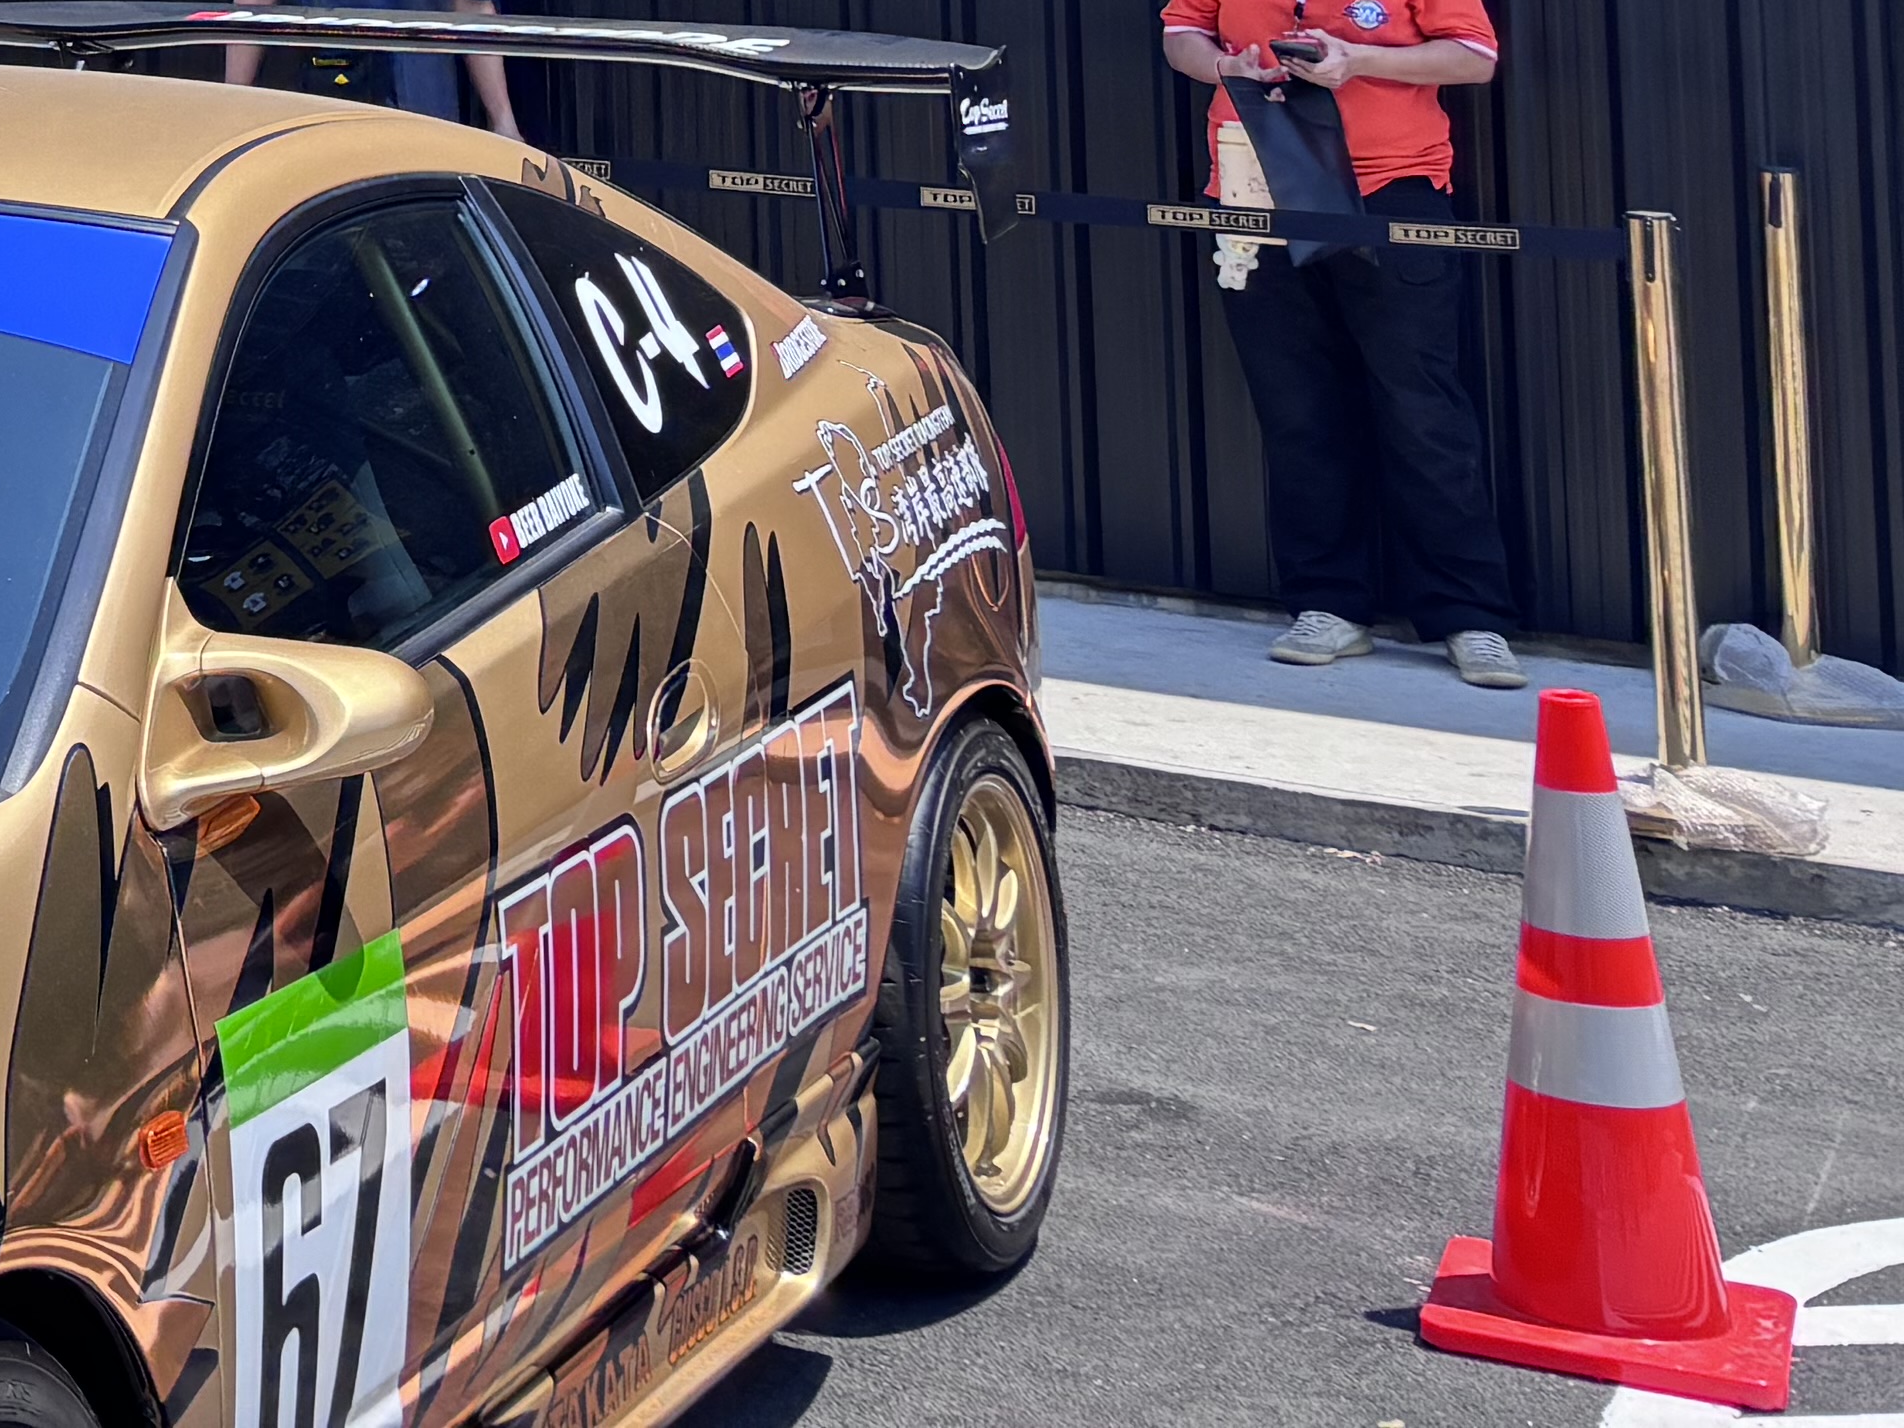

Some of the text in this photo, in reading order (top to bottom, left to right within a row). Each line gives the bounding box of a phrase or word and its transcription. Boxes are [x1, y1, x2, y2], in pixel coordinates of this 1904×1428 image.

[763, 176, 815, 194] SECRET
[930, 190, 975, 206] TOP
[1155, 207, 1268, 230] TOP SECRET
[1398, 227, 1518, 248] TOP SECRET
[498, 681, 860, 1148] TOP SECRET
[506, 1058, 666, 1268] PERFORMANCE
[670, 972, 788, 1126] ENGINEERING
[789, 912, 867, 1034] SERVICE
[259, 1076, 387, 1428] 67
